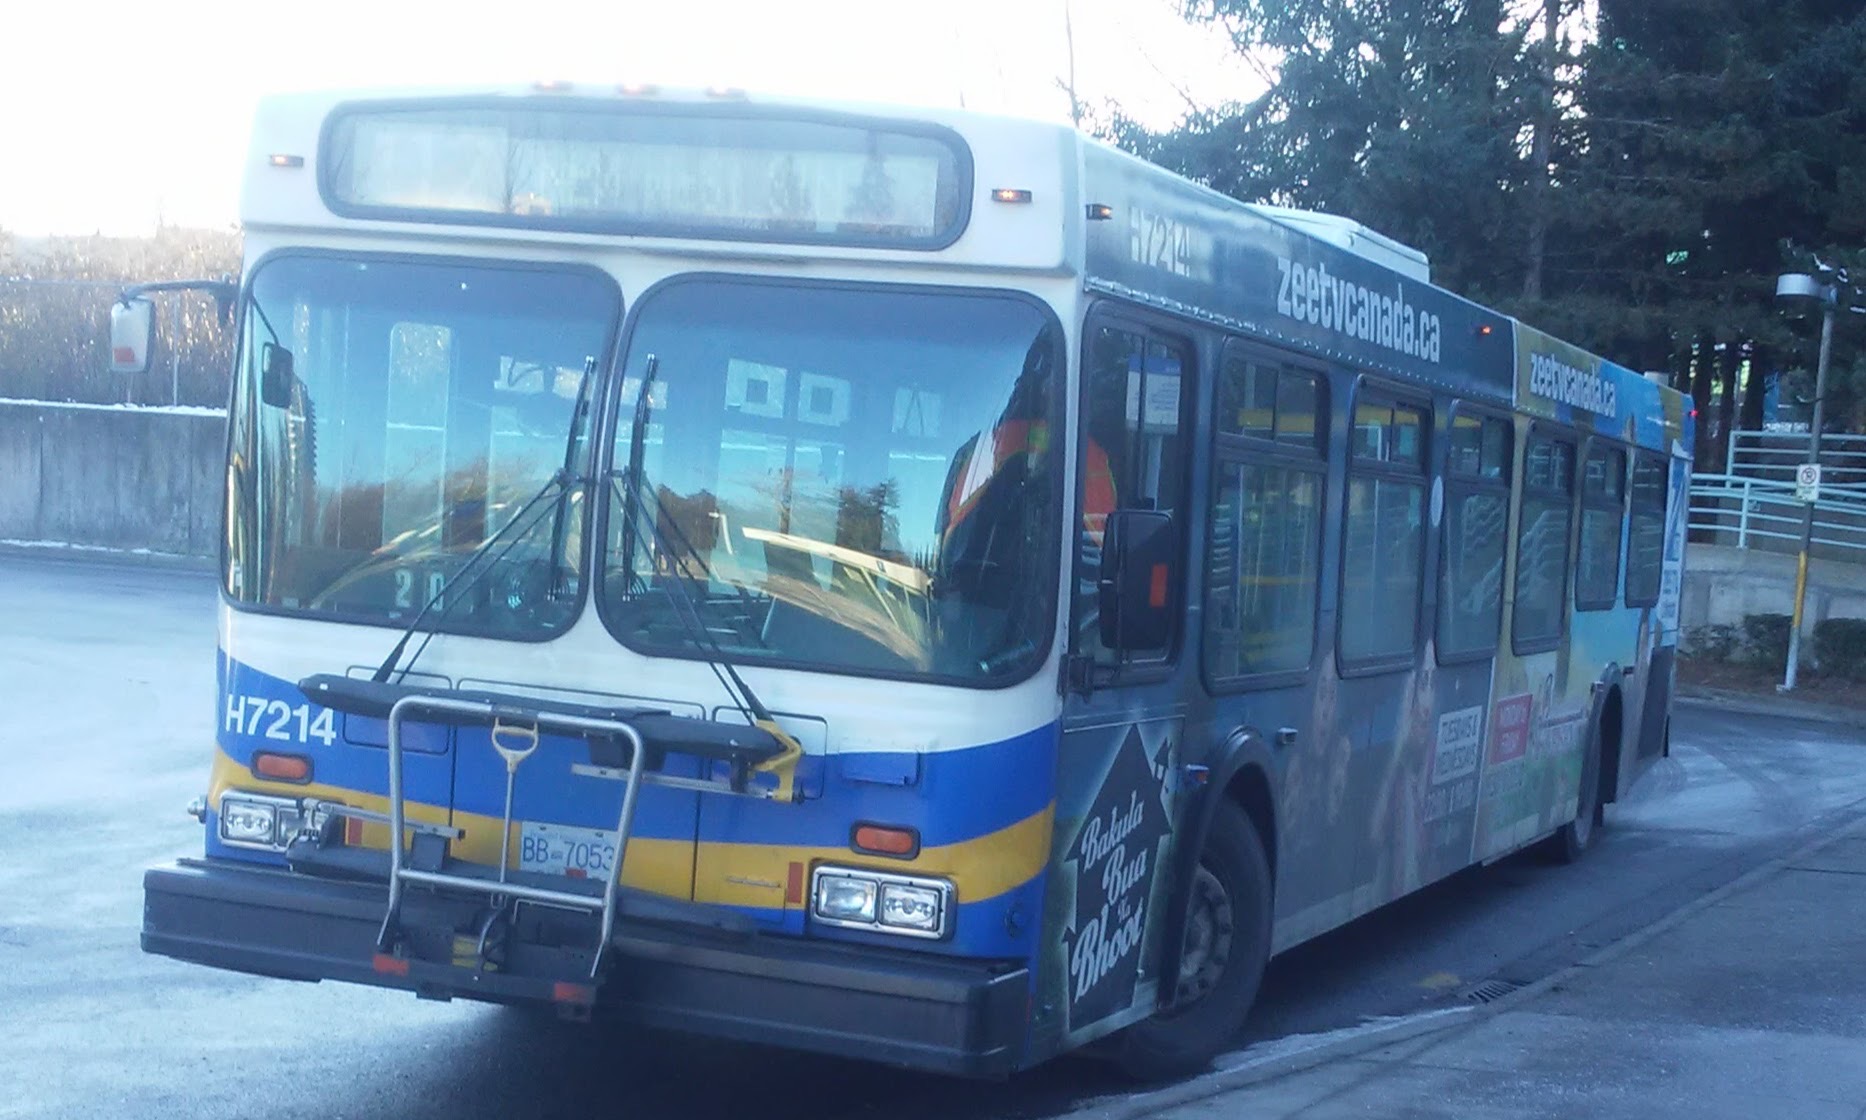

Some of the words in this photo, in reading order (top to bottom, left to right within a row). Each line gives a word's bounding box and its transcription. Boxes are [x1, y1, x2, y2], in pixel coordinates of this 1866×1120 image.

[1130, 205, 1190, 278] H7214
[1277, 257, 1441, 363] zeetvcanada.ca
[1529, 353, 1616, 418] zeetvcanada.ca
[226, 694, 336, 746] H7214
[523, 837, 548, 863] BB
[1081, 789, 1144, 873] Bakula
[1102, 843, 1147, 906] Bua
[1071, 896, 1144, 1004] Bhoot
